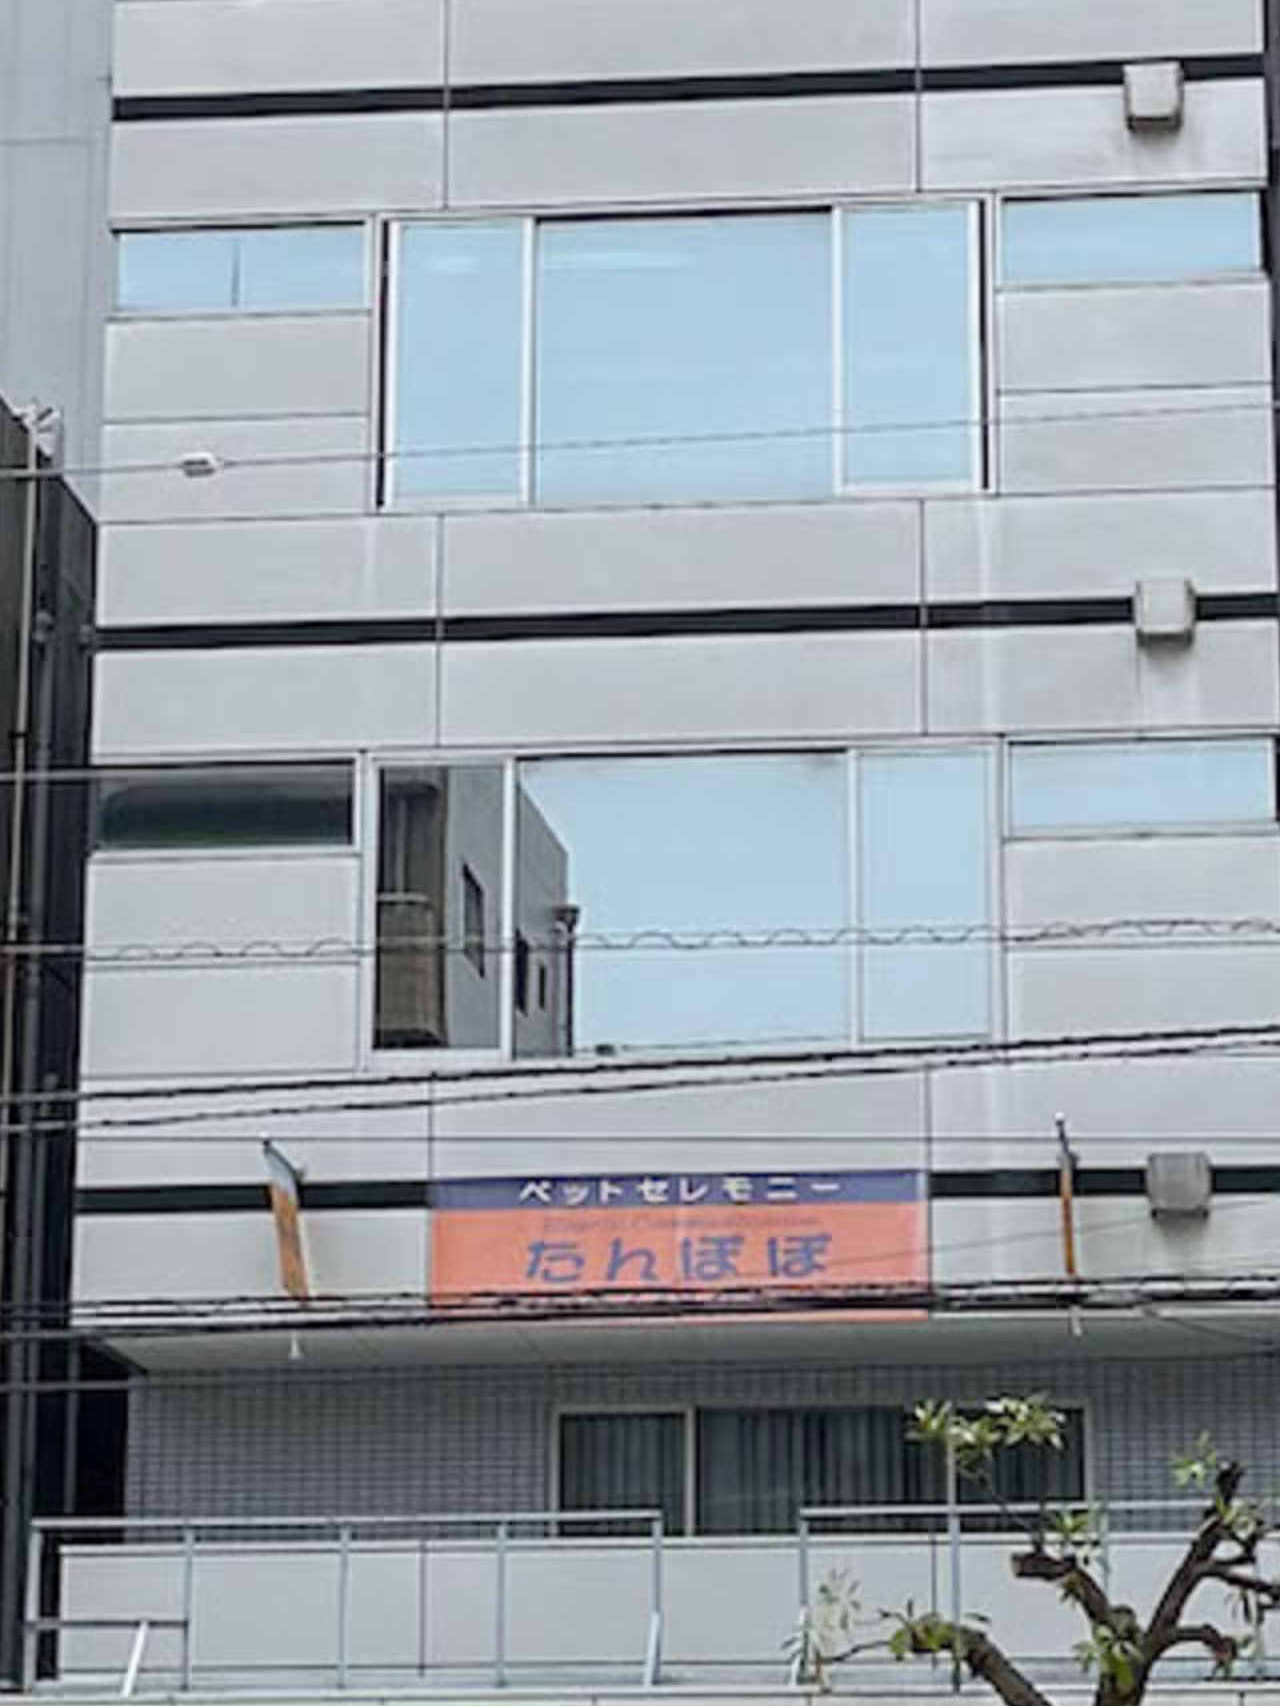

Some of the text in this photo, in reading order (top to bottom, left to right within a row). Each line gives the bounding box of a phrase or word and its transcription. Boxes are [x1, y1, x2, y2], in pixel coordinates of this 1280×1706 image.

[520, 1176, 840, 1205] ペットセレモニー
[525, 1233, 834, 1283] たんぽぽ
